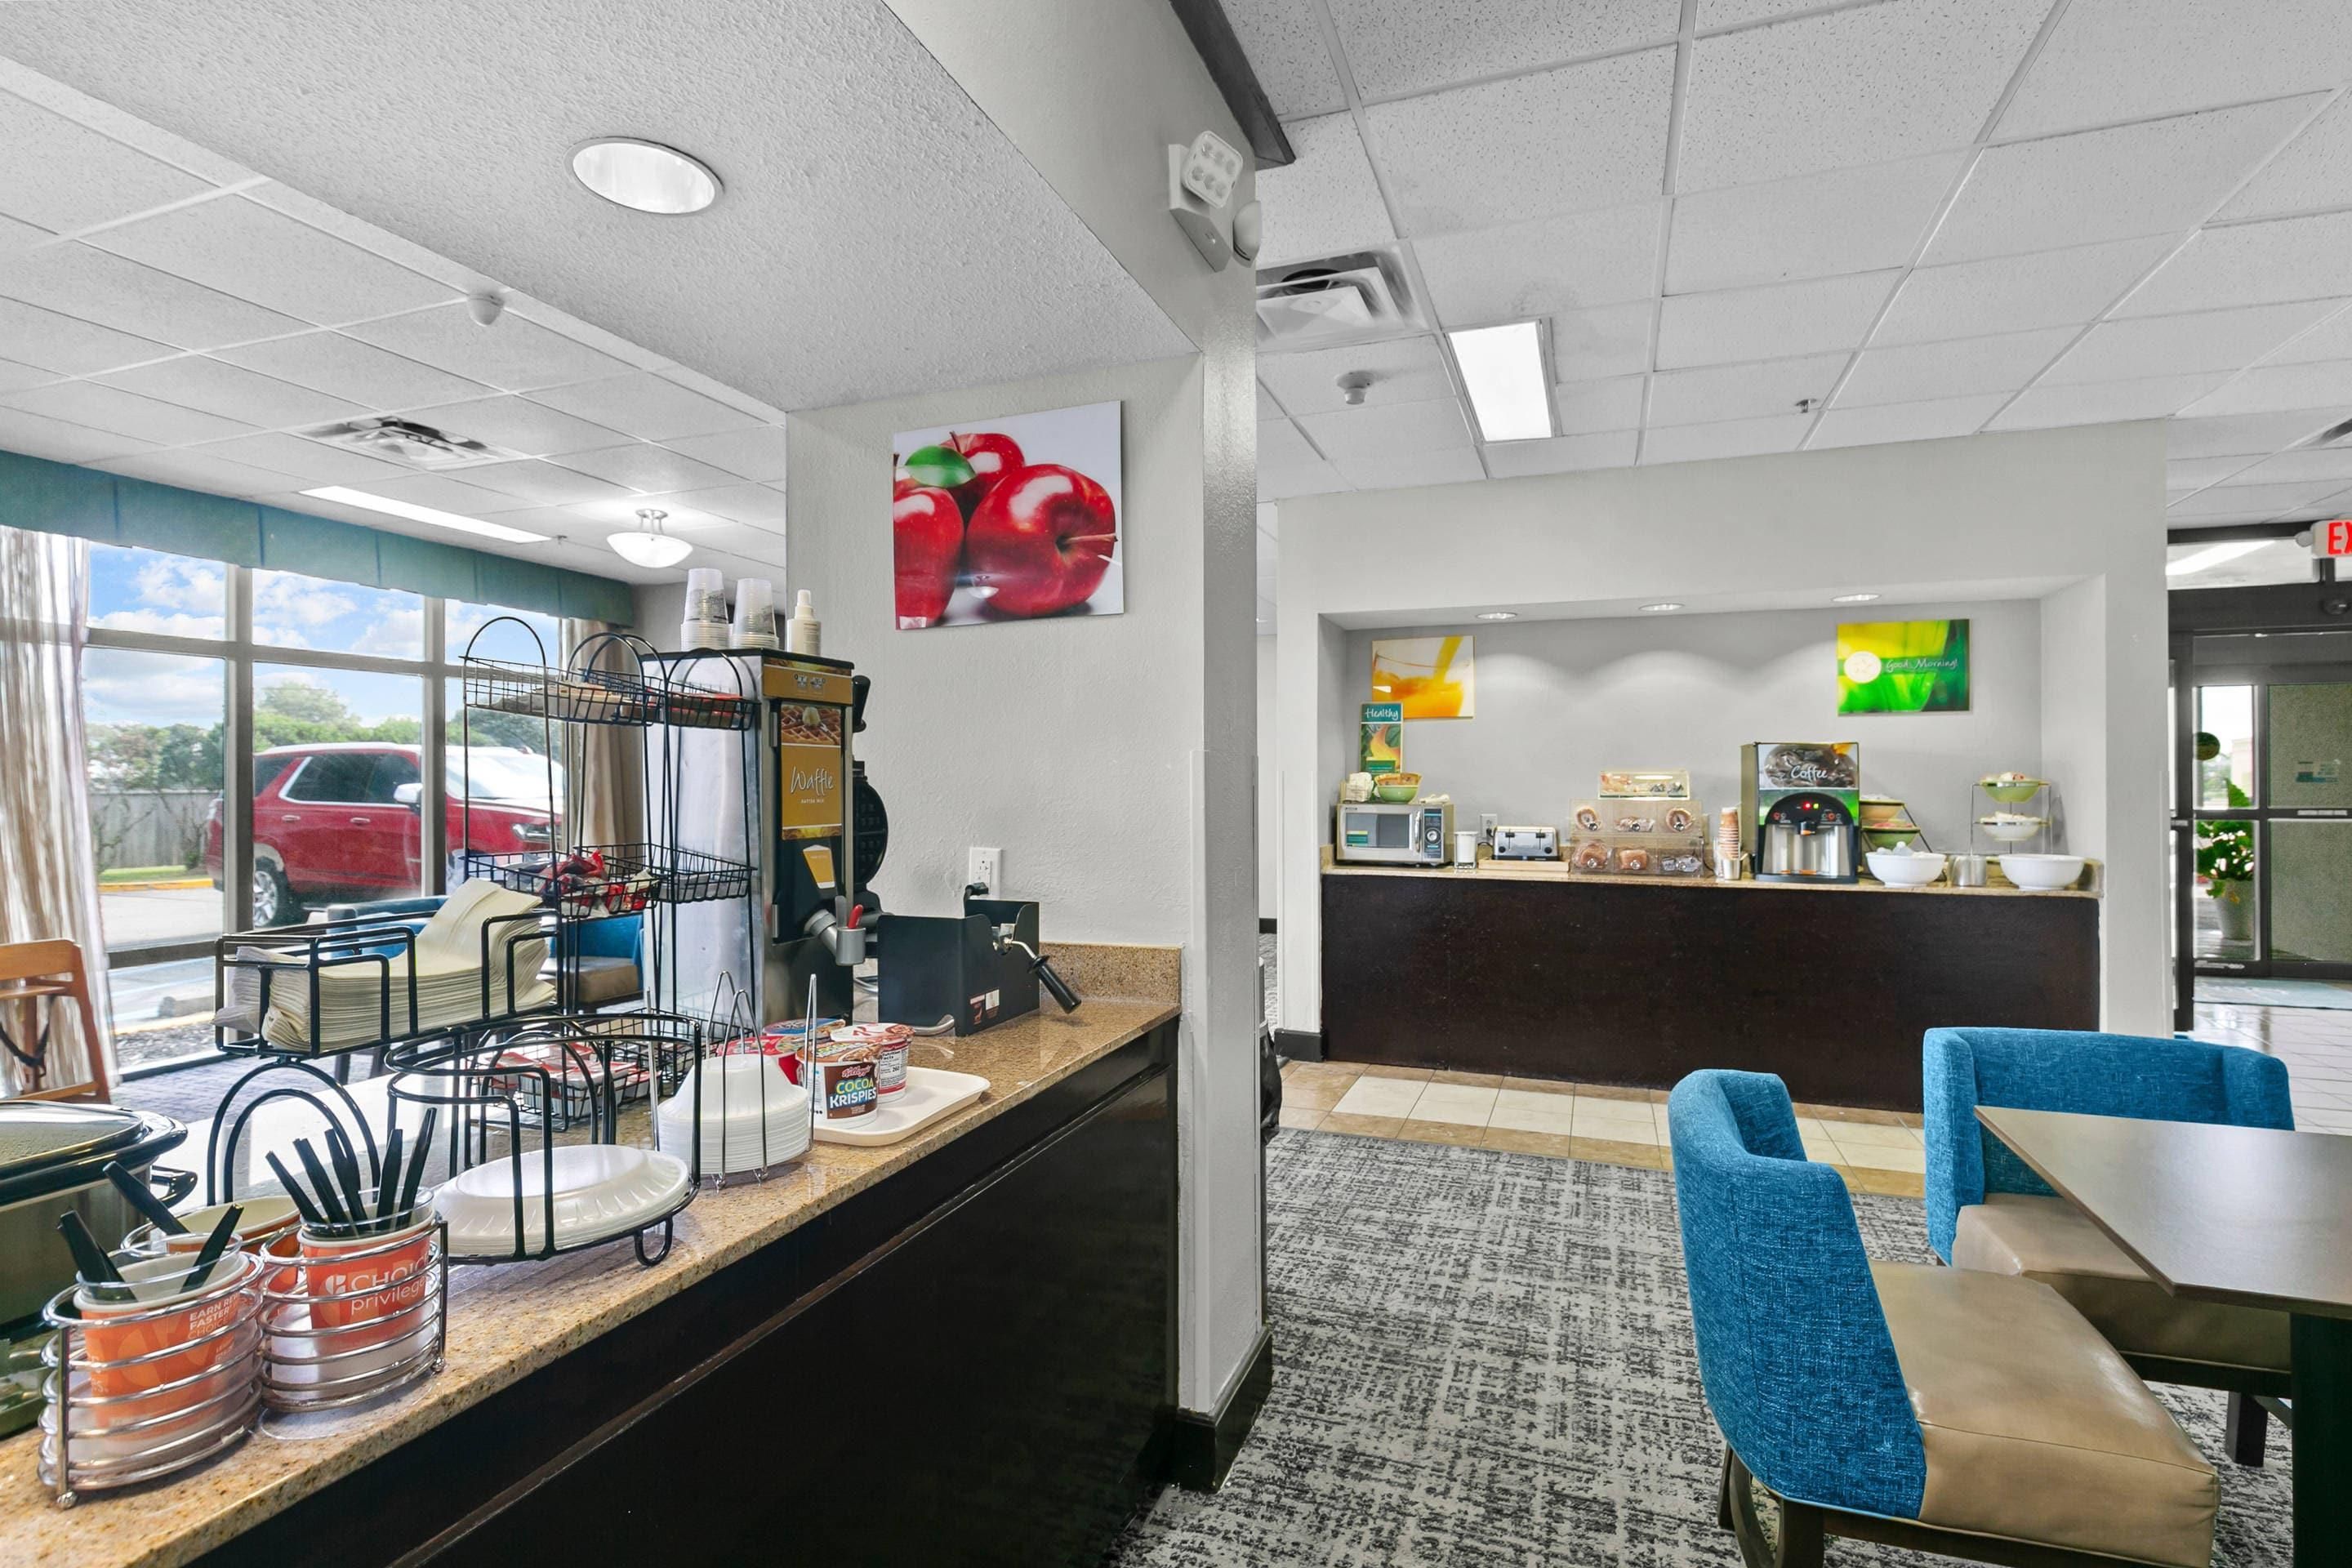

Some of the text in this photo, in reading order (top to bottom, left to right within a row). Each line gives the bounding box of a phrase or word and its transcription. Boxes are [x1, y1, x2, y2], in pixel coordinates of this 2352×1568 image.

[1886, 659, 1909, 673] Good
[1365, 707, 1399, 721] Healthy
[790, 766, 834, 796] Waffle
[1790, 764, 1829, 782] Coffee
[836, 1078, 874, 1094] COCOA
[830, 1087, 877, 1109] KRISPIES
[189, 1301, 221, 1322] EARN
[189, 1306, 229, 1330] FASTER
